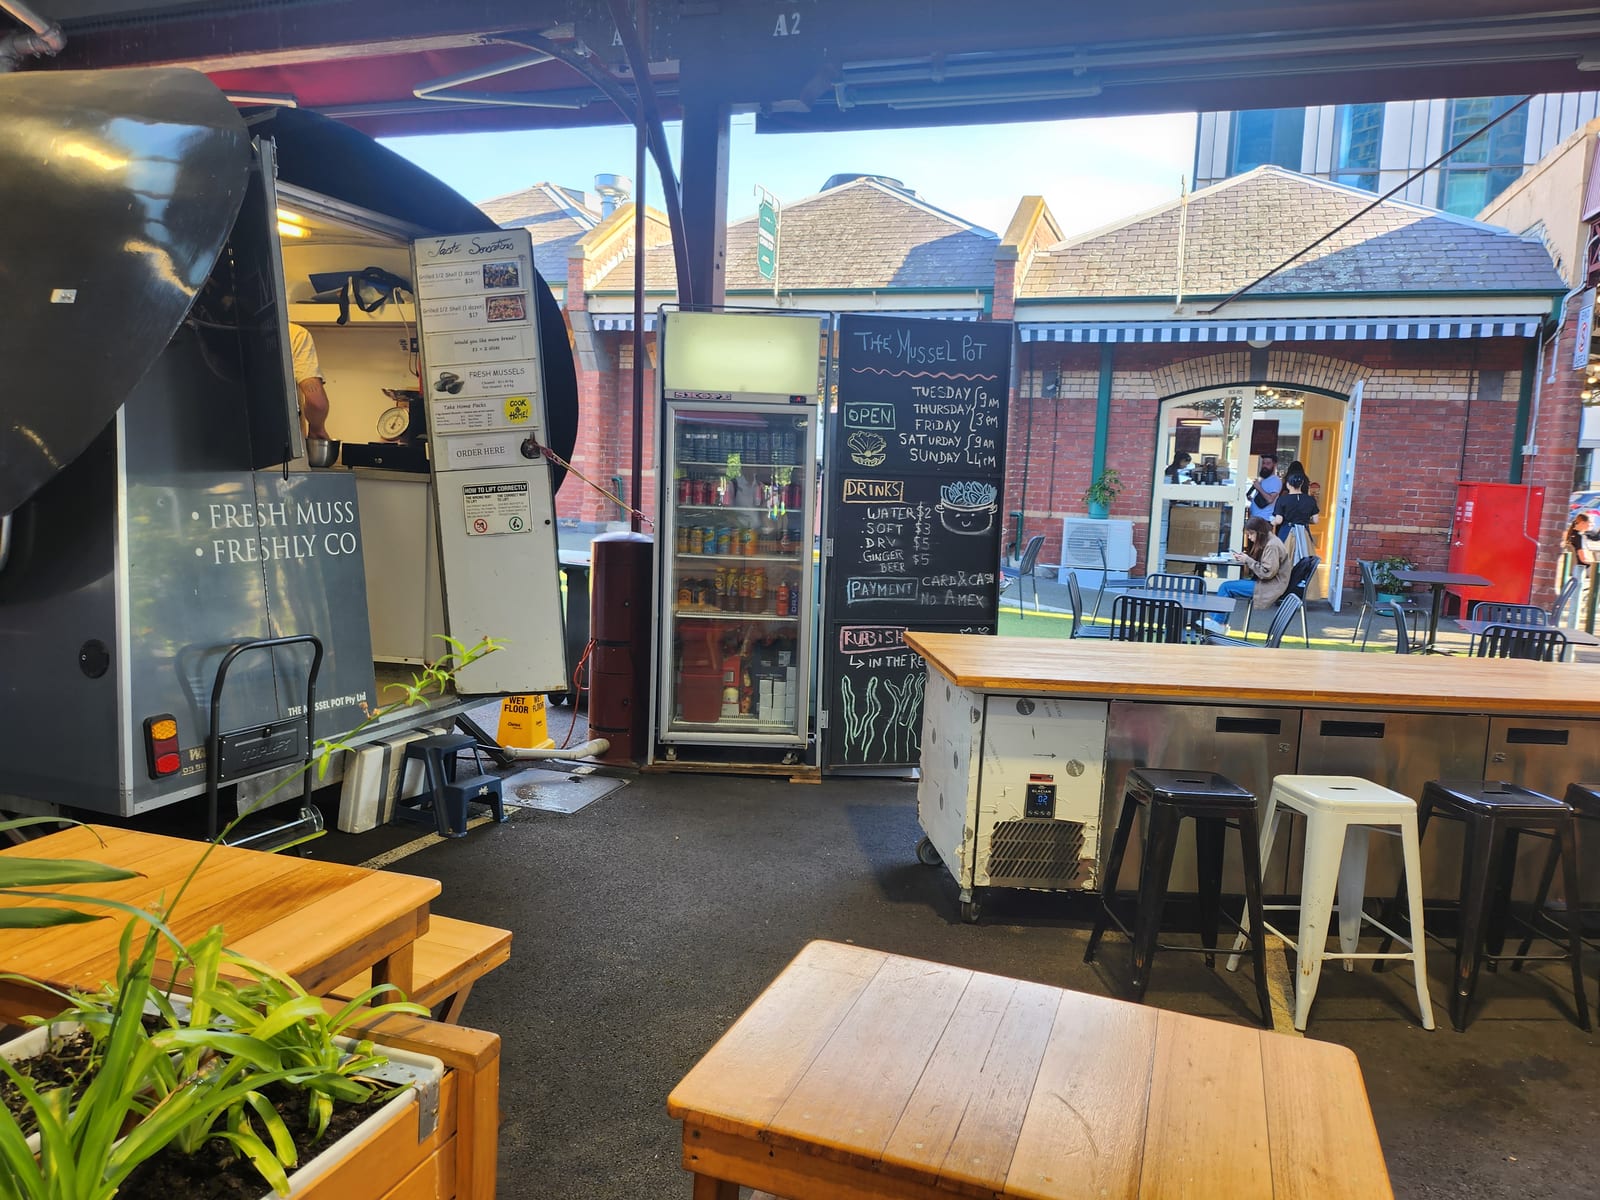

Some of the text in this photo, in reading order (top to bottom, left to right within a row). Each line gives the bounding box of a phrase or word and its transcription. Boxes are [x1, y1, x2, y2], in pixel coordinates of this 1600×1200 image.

[853, 328, 988, 364] THE MUSSEL POT
[469, 368, 525, 378] FRESH MUSSELS
[911, 386, 971, 400] TUESDAY
[509, 399, 527, 408] COOK
[913, 403, 972, 415] THURSDAY
[849, 407, 891, 424] OPEN
[899, 433, 962, 447] SATURDAY
[456, 446, 505, 458] ORDER HERE
[909, 447, 962, 464] SUNDAY
[847, 481, 901, 498] DRINKS
[208, 500, 355, 529] FRESH MUSS
[867, 506, 916, 520] WATER
[866, 522, 903, 535] SOFT
[212, 531, 357, 565] FRESHLY CO
[862, 549, 905, 562] GINGER
[879, 562, 906, 573] BEER
[850, 581, 913, 598] PAYMENT
[885, 654, 907, 668] THE
[287, 705, 302, 717] THE
[330, 696, 345, 708] POT
[345, 695, 356, 706] Pty
[509, 696, 525, 705] WET
[504, 704, 529, 714] FLOOR
